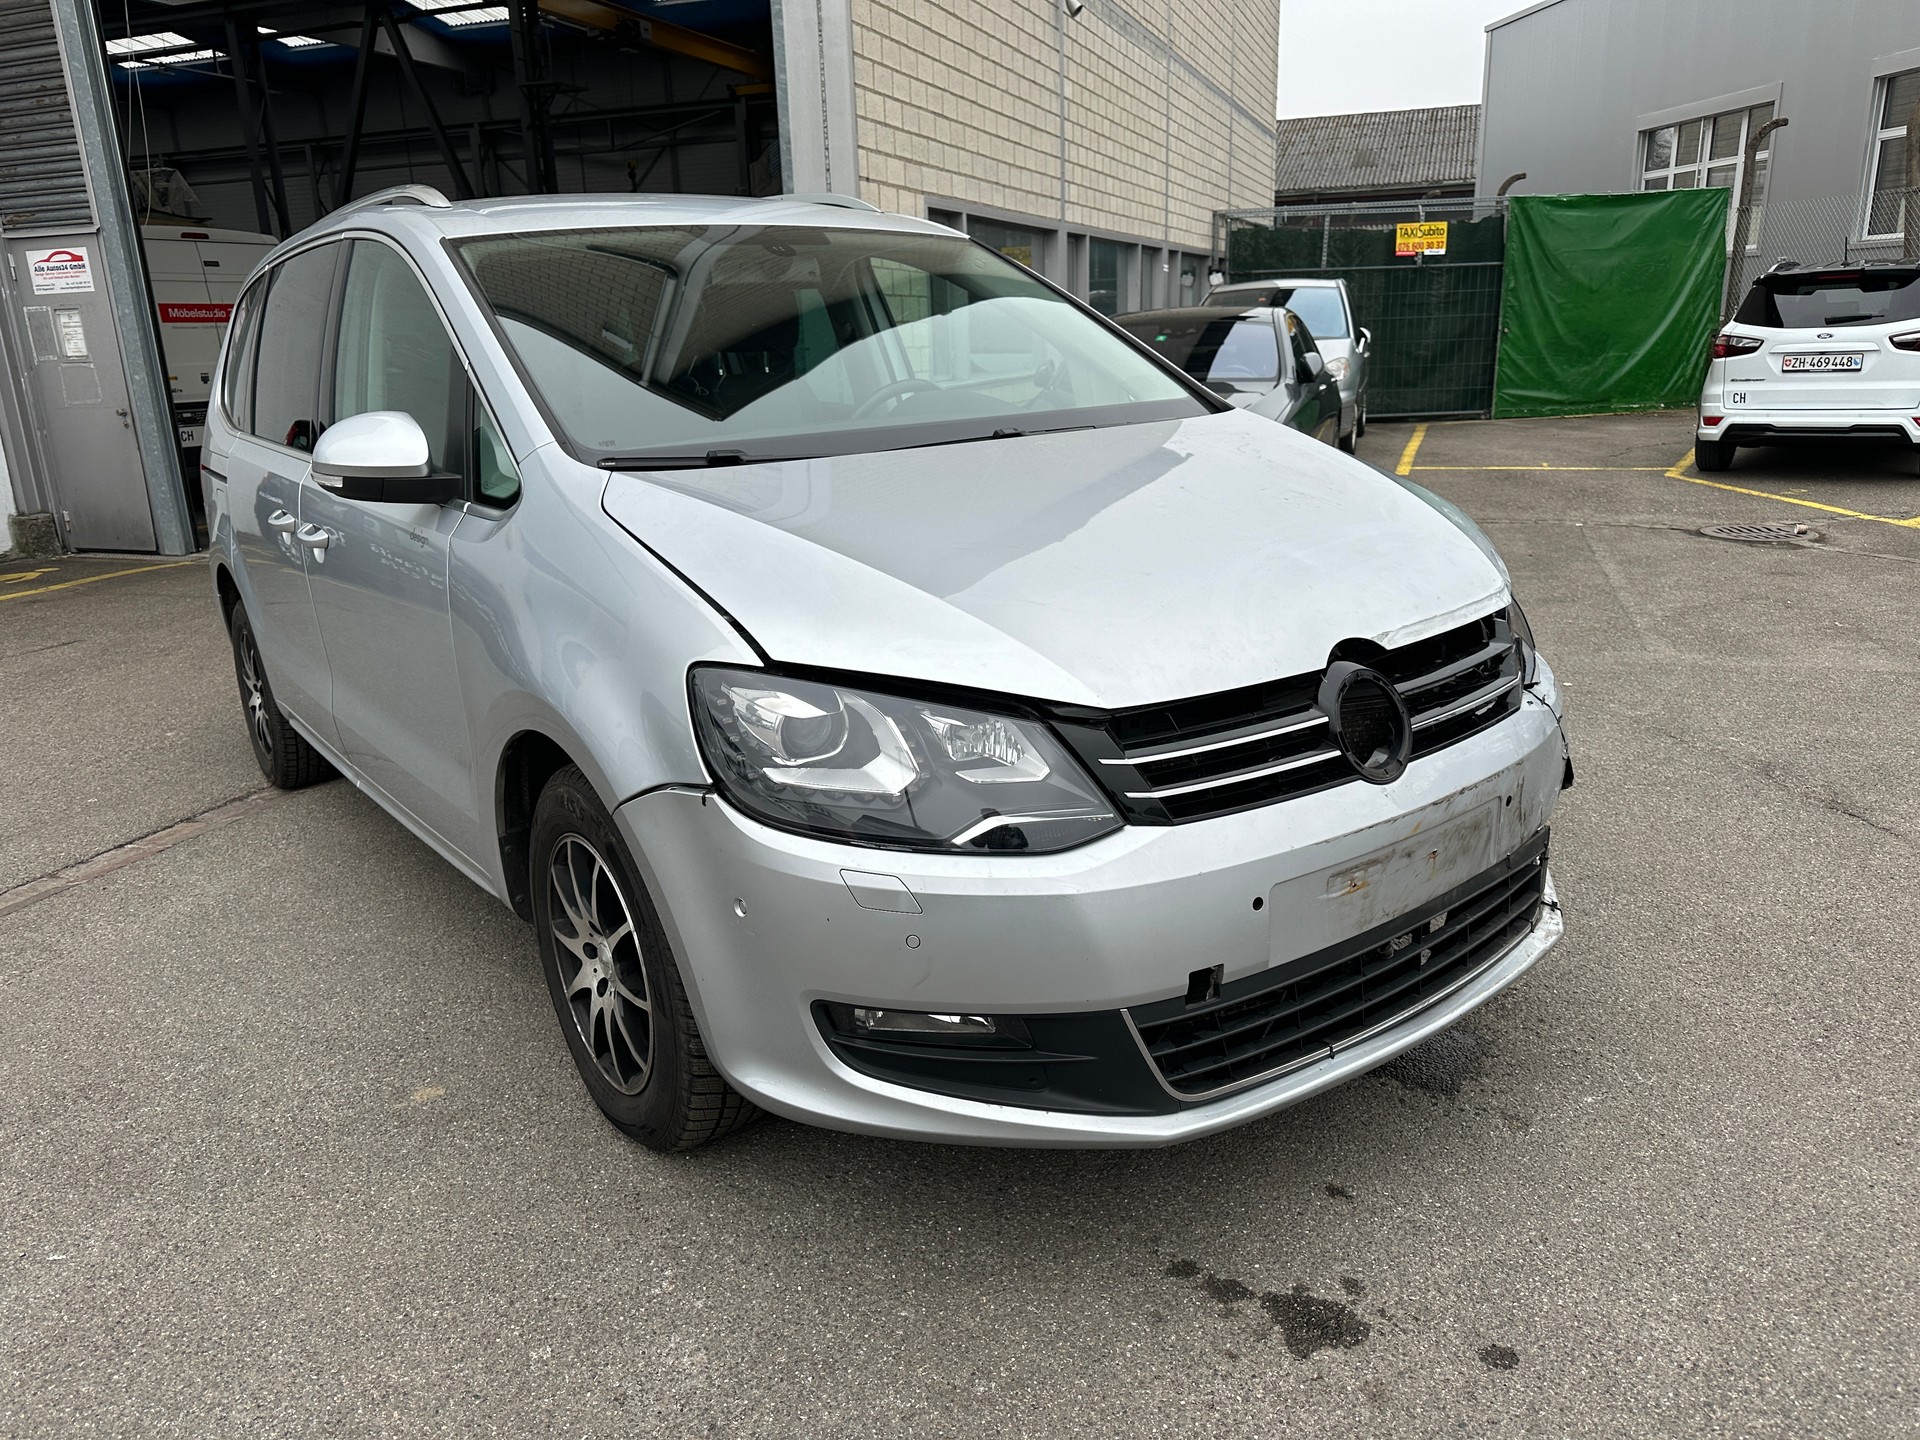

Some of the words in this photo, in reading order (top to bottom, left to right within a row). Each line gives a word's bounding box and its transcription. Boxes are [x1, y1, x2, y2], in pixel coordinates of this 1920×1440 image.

[1398, 242, 1410, 251] 076
[1412, 241, 1424, 250] 600
[1436, 240, 1444, 249] 37
[168, 307, 227, 318] Möbelstudio
[1733, 392, 1746, 404] CH
[180, 430, 194, 442] CH
[409, 528, 429, 548] design
